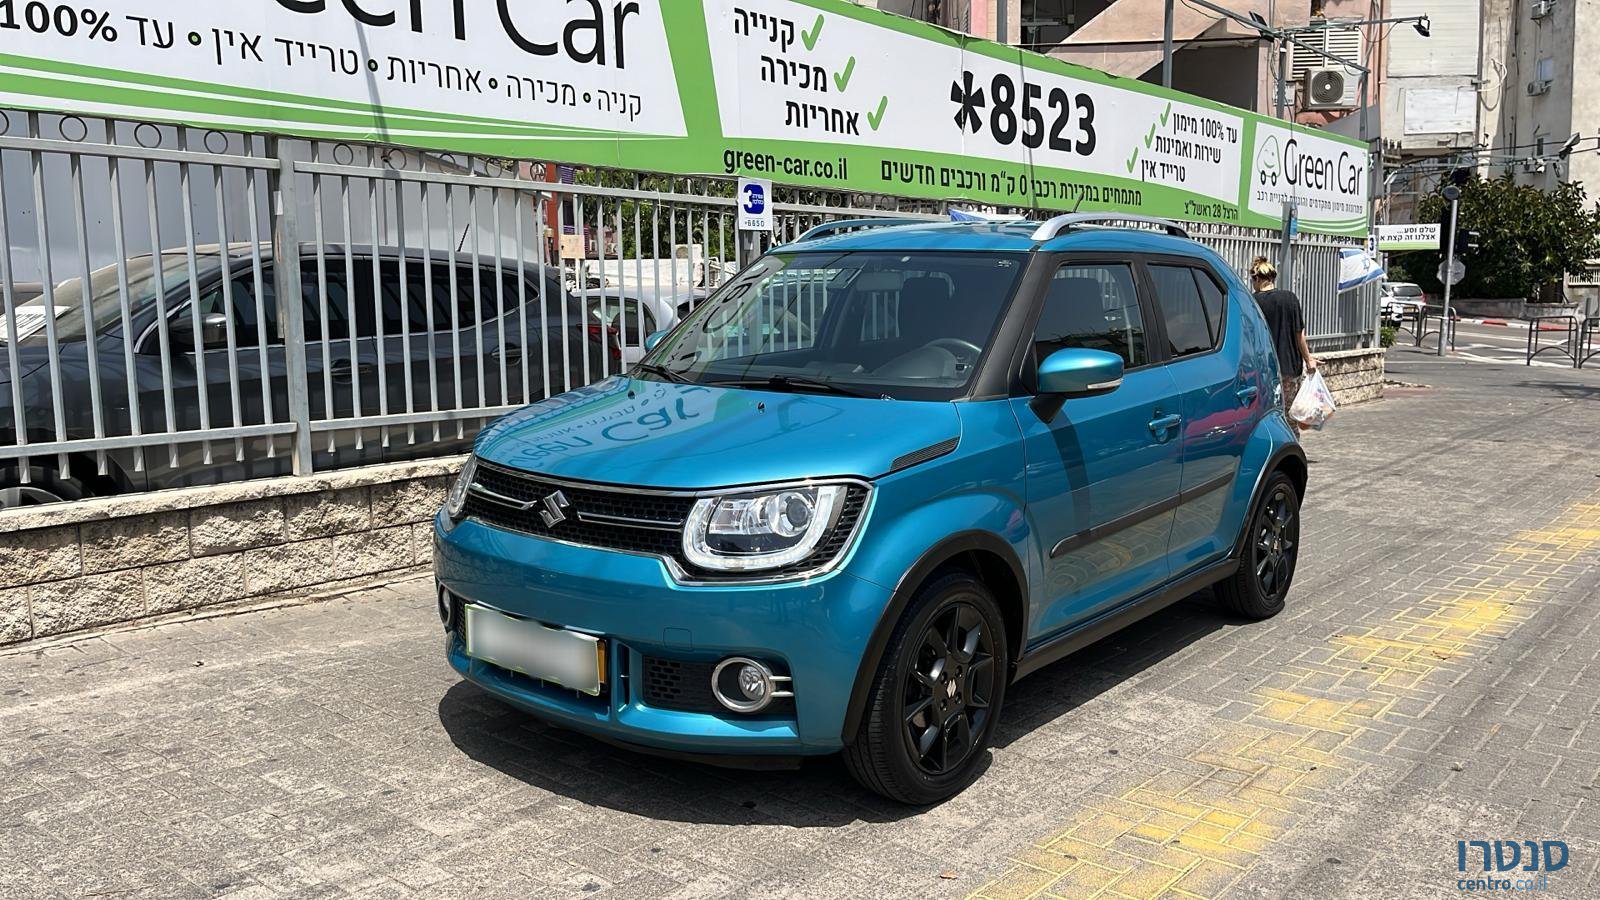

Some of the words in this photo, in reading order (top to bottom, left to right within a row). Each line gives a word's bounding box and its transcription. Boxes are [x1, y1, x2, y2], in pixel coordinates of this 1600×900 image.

[0, 0, 118, 42] 100%
[125, 15, 175, 49] עד
[733, 7, 795, 54] קנייה
[212, 27, 263, 65] אין
[274, 37, 359, 75] טרייד
[387, 56, 482, 93] אחריות
[761, 55, 827, 93] מכירה
[506, 75, 576, 106] מכירה
[598, 89, 642, 122] קניה
[785, 101, 860, 136] אחריות
[1173, 113, 1197, 135] מימון
[1201, 117, 1224, 140] 100%
[1226, 127, 1237, 143] עד
[1155, 136, 1192, 158] ואמינות
[1194, 144, 1221, 163] שירות
[724, 149, 848, 180] green-car.co.il
[881, 160, 935, 186] חדשים
[1141, 159, 1157, 182] אין
[1160, 163, 1185, 182] טרייד
[1284, 138, 1334, 191] Green
[1338, 151, 1362, 196] Car
[941, 167, 986, 191] ורכבים
[1020, 174, 1028, 196] 0
[1102, 187, 1142, 206] מתמחים
[1213, 204, 1221, 219] 28
[1222, 203, 1238, 221] הרצל
